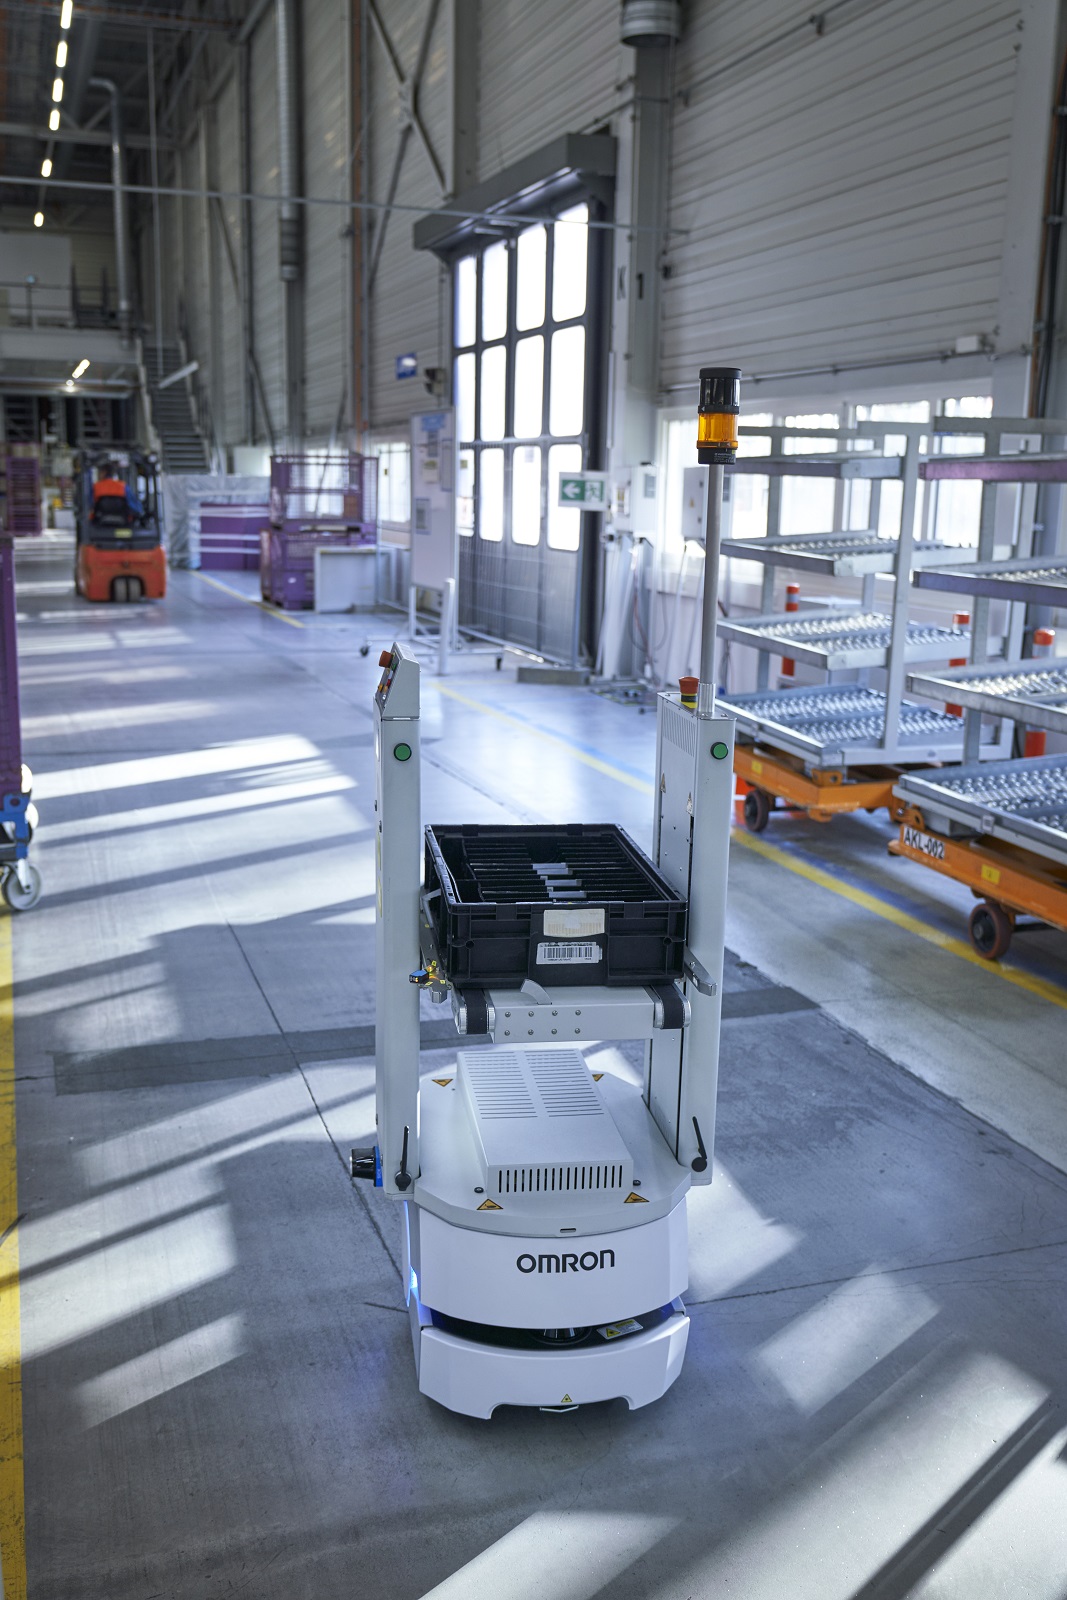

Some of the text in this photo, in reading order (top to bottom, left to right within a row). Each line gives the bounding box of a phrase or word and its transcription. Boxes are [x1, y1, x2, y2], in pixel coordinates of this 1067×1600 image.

[616, 266, 645, 301] K 1
[904, 827, 944, 859] AKL-002
[516, 1249, 615, 1273] OMRON
